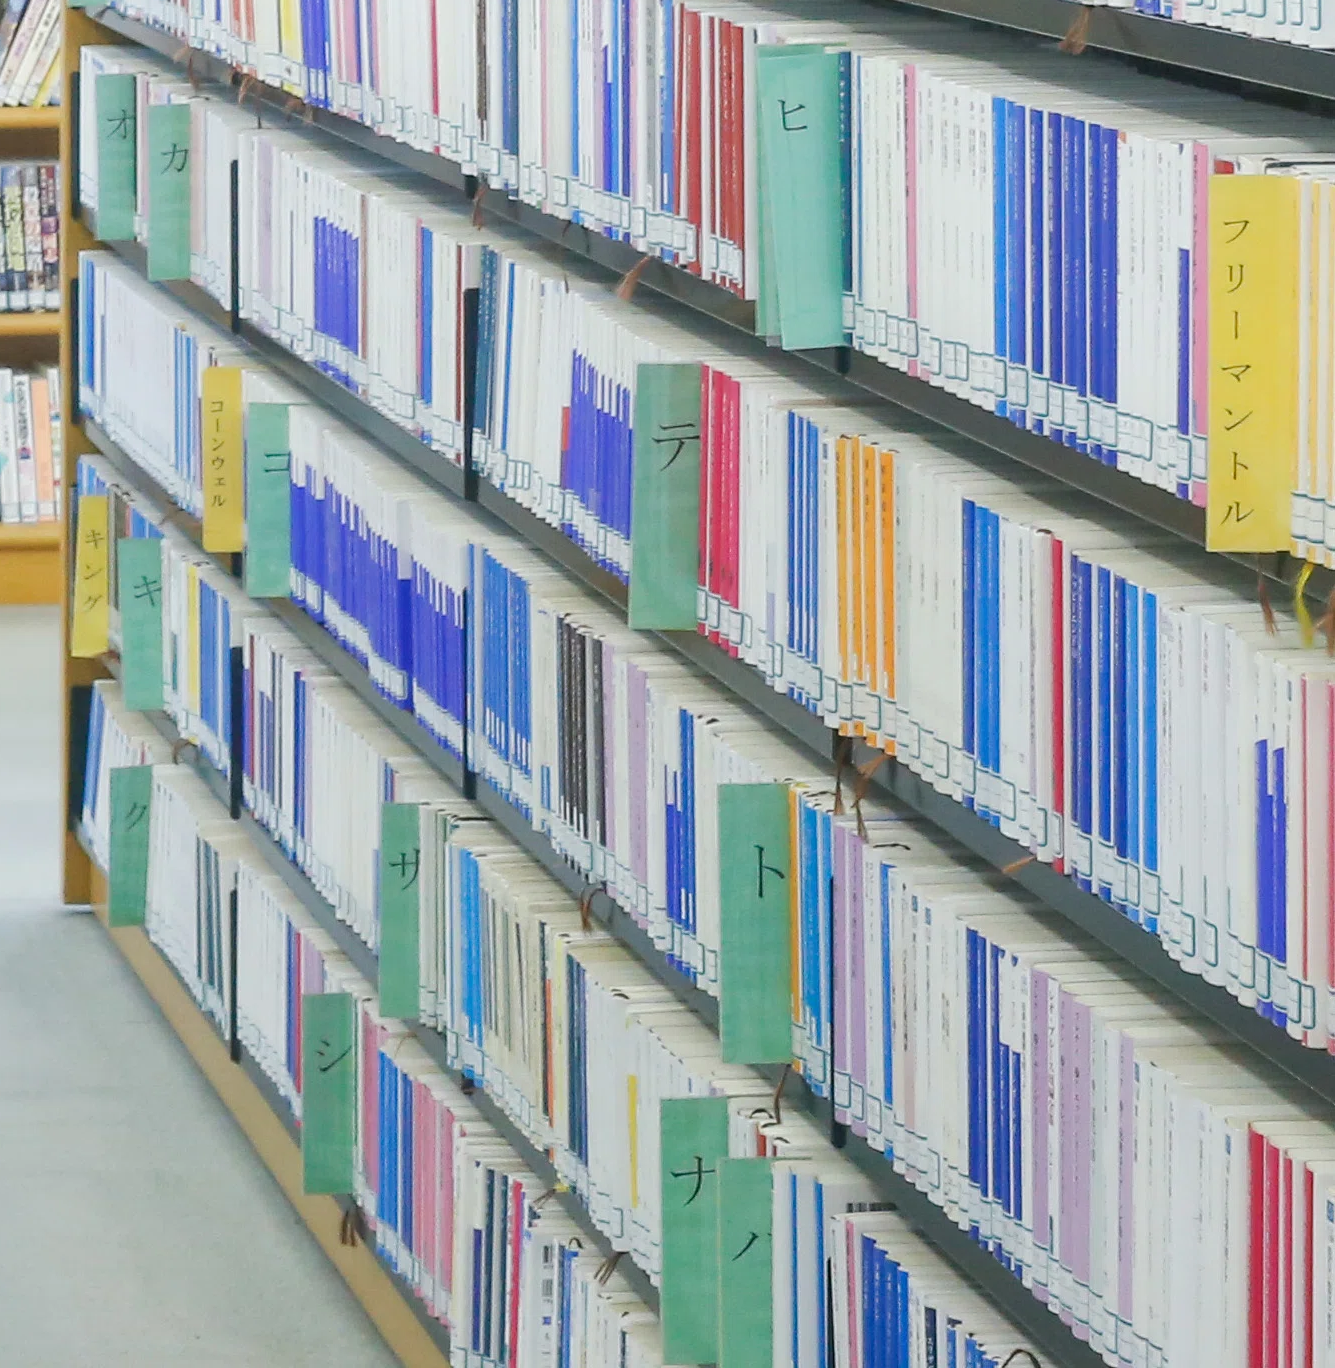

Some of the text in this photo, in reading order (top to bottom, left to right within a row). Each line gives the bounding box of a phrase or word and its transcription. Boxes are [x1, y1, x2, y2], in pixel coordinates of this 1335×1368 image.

[107, 107, 136, 147] オ
[777, 99, 808, 132] ヒ
[161, 142, 190, 173] カ
[1220, 219, 1255, 525] フリーマントル
[210, 400, 227, 507] コーンウェル
[651, 422, 702, 470] テ
[83, 529, 106, 610] キング
[133, 575, 163, 608] キ
[388, 848, 421, 891] サ
[754, 844, 786, 899] ト
[316, 1039, 349, 1074] シ
[670, 1155, 716, 1206] ナ
